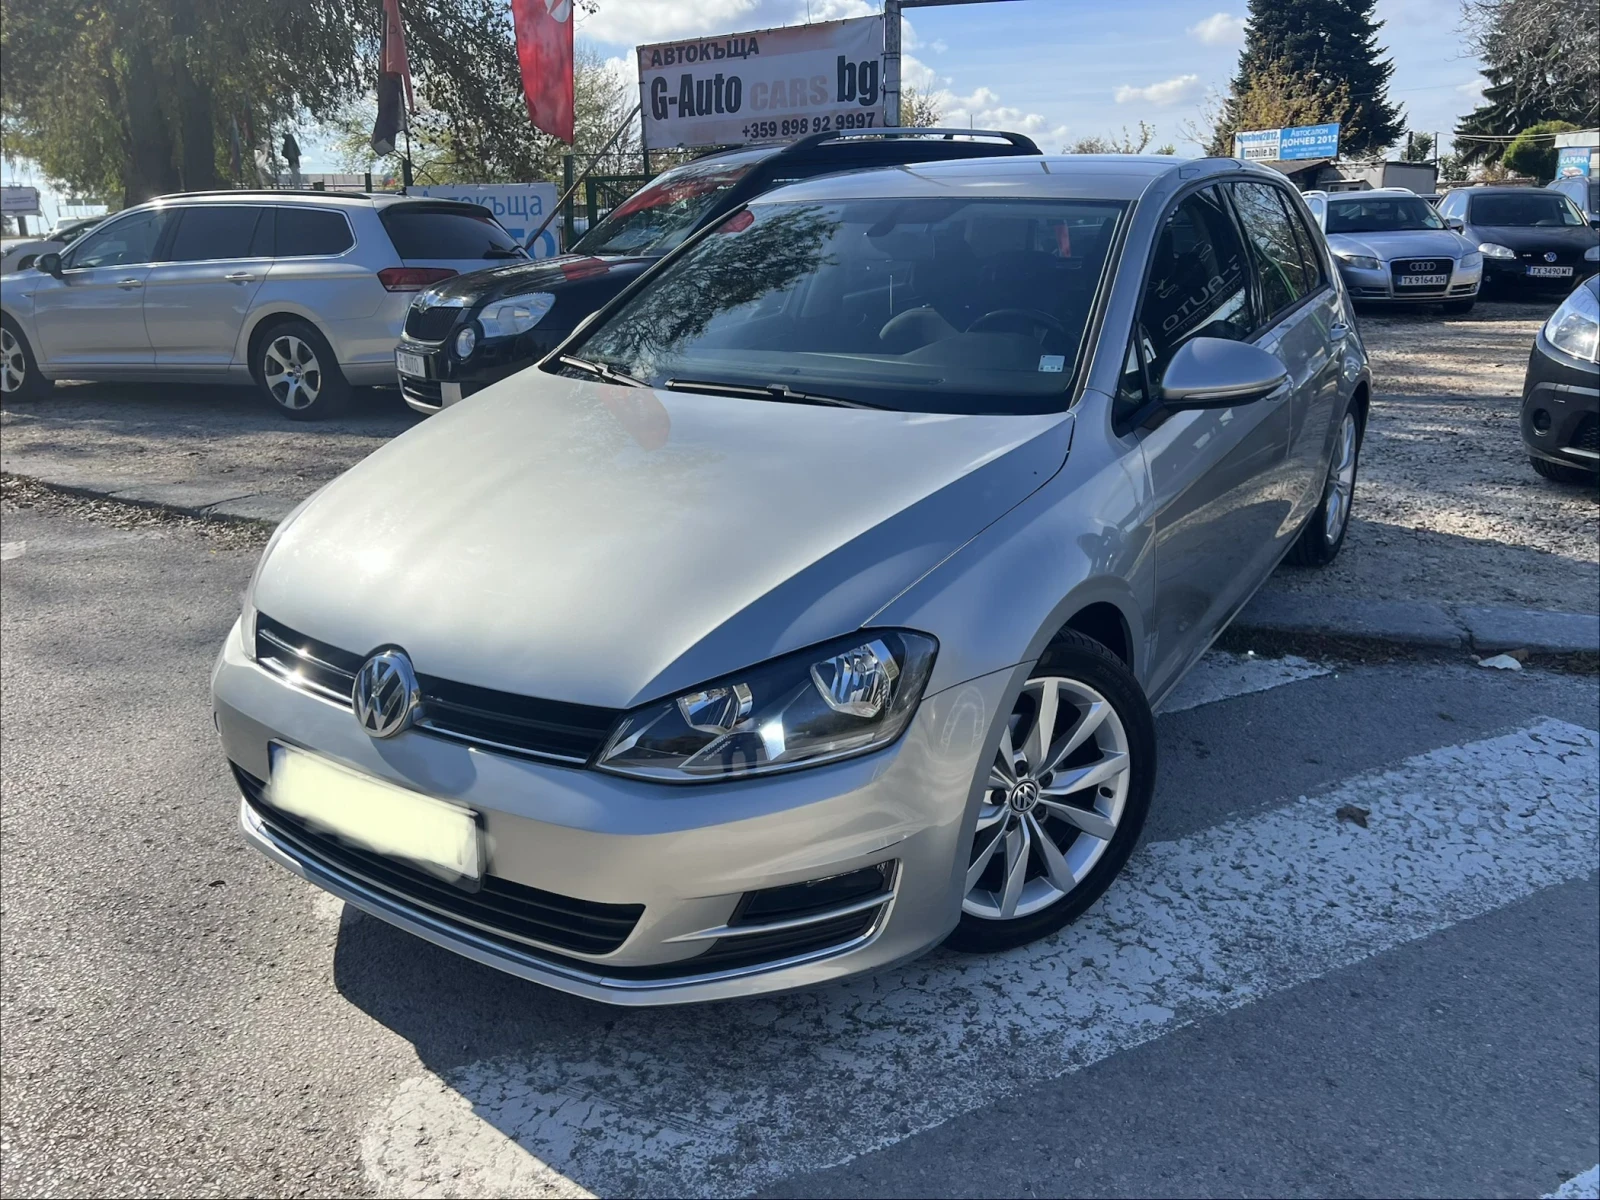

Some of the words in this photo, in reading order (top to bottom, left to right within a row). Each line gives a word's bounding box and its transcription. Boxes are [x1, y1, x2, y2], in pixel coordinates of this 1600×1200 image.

[651, 37, 760, 67] АВТОКЪЩА
[651, 73, 742, 121] G-Auto
[742, 121, 777, 139] +359
[781, 118, 808, 136] 898
[813, 116, 830, 133] 92
[835, 112, 875, 130] 9997
[1281, 137, 1316, 148] ДОНЧЕВ
[1317, 134, 1338, 144] 2012
[1245, 148, 1277, 158] mobile.bg
[1532, 267, 1542, 275] TX
[1543, 267, 1561, 275] 3490
[1403, 276, 1413, 284] TX
[1415, 275, 1433, 284] 9164
[1435, 275, 1446, 284] XH
